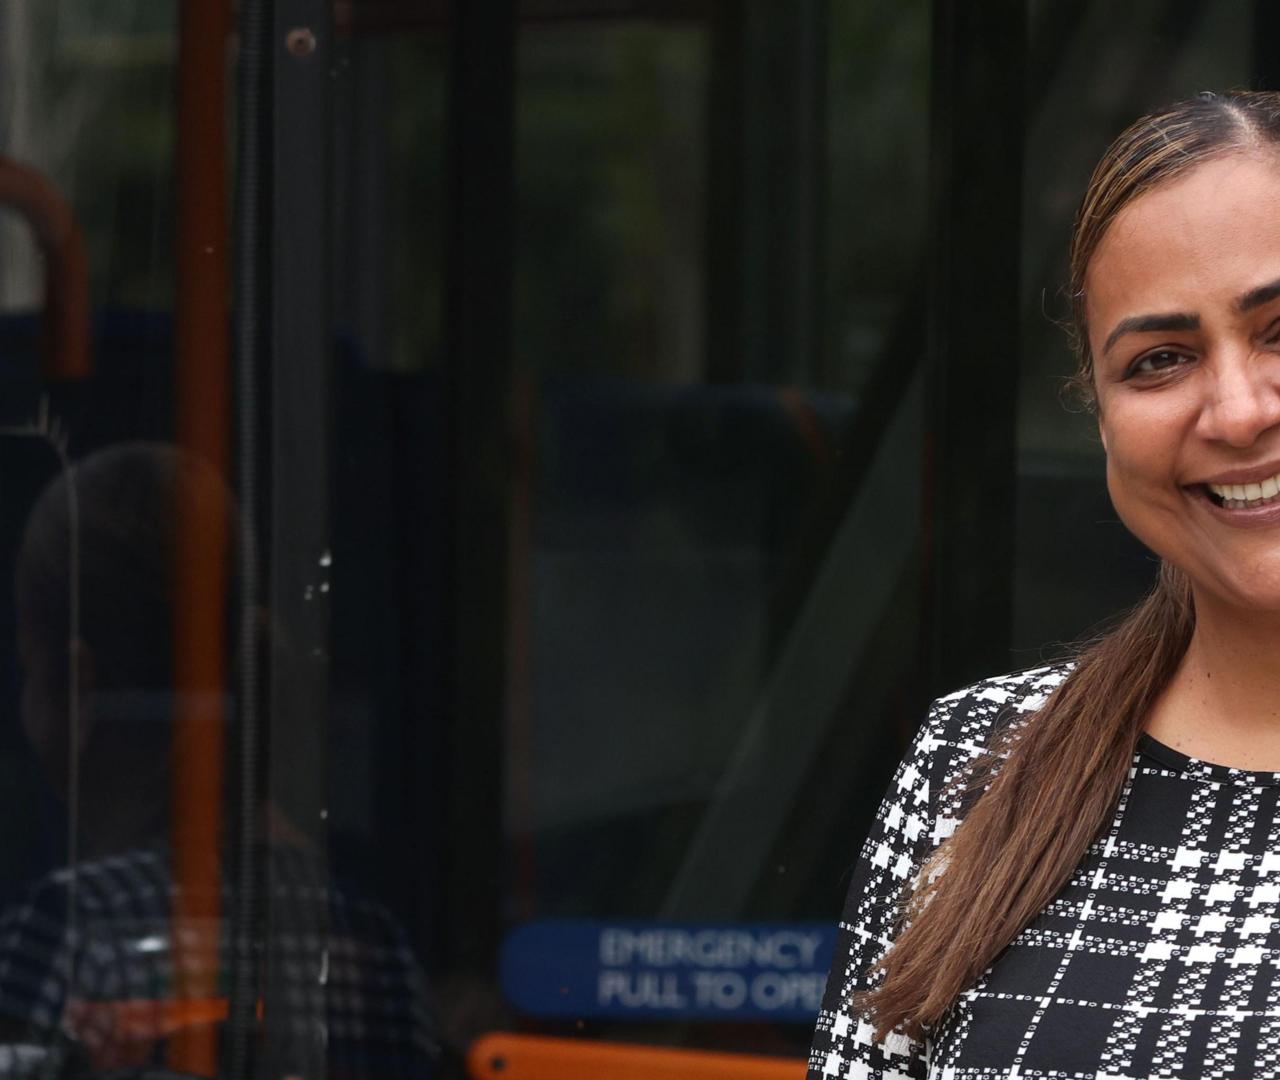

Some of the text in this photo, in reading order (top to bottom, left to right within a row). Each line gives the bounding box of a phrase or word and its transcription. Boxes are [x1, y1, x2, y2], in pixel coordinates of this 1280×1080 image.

[599, 927, 821, 967] EMERGENCY
[596, 970, 828, 1011] PULL TO OPE
